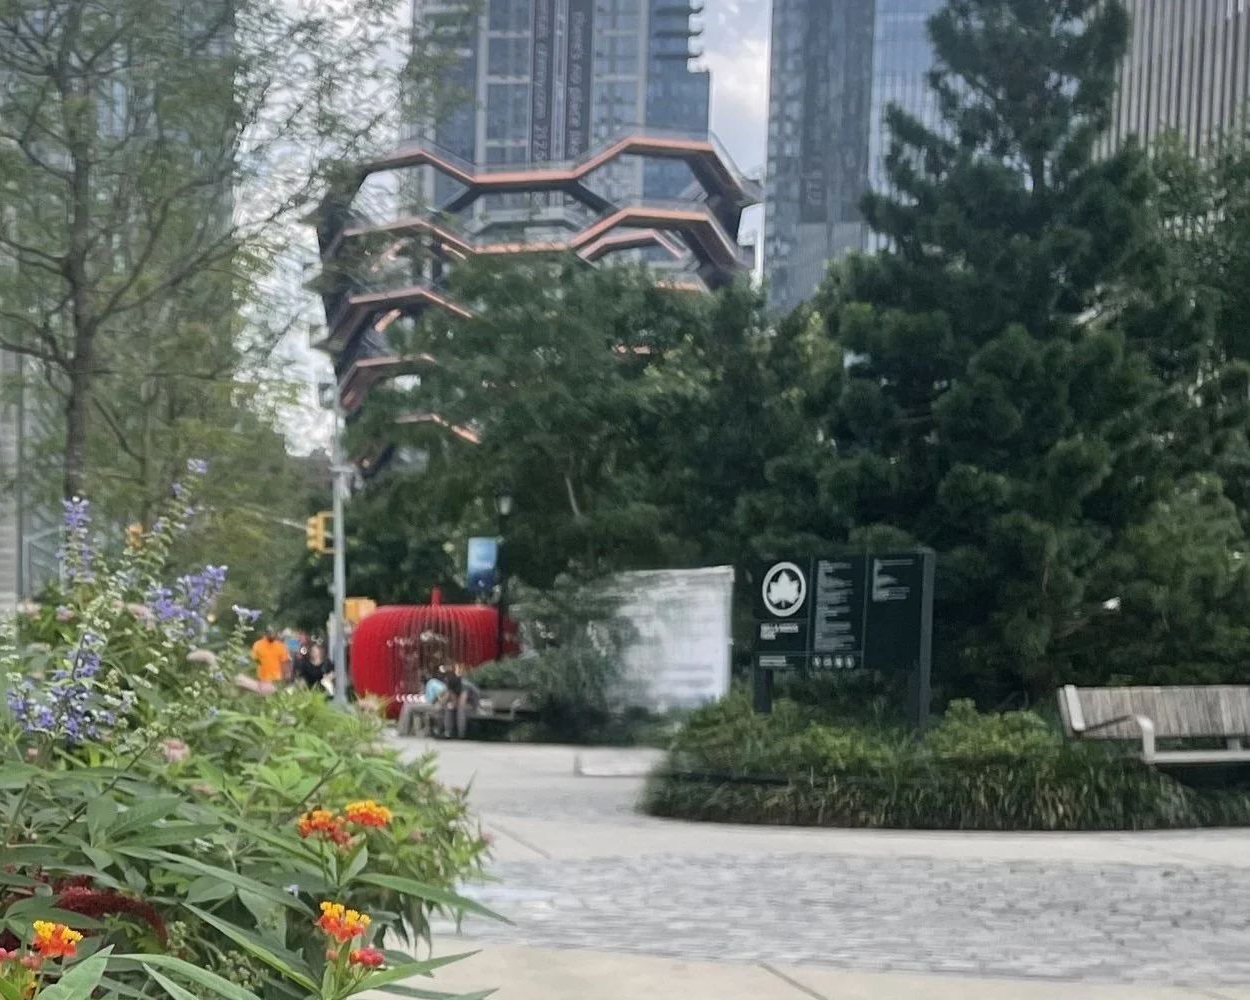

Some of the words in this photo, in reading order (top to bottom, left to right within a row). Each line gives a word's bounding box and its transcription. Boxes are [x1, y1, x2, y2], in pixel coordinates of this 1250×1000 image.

[570, 11, 586, 60] there's
[570, 63, 583, 84] no
[568, 86, 583, 128] place
[568, 130, 583, 157] like
